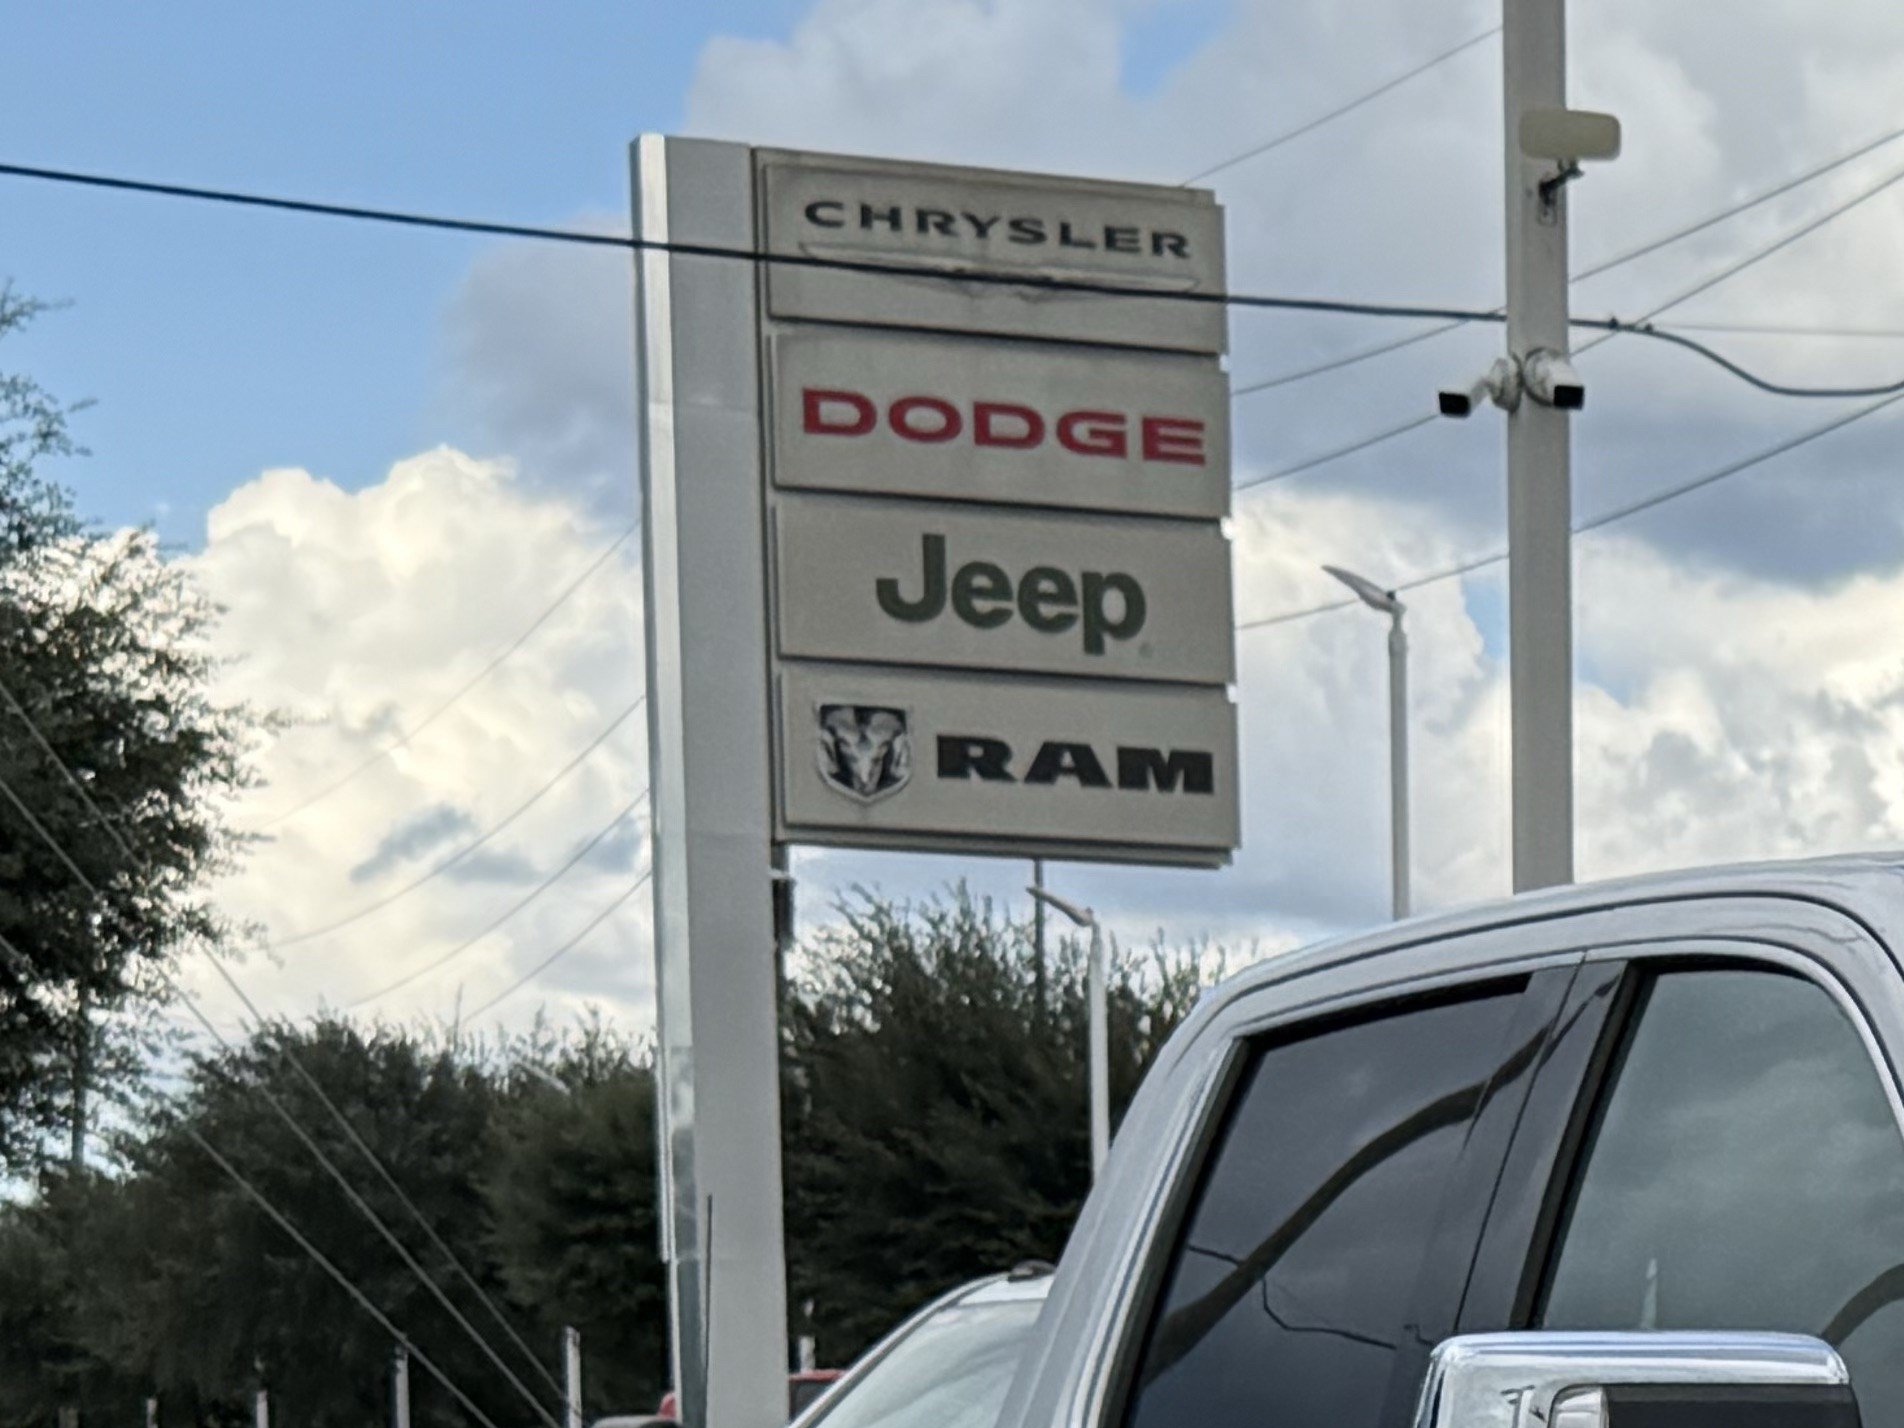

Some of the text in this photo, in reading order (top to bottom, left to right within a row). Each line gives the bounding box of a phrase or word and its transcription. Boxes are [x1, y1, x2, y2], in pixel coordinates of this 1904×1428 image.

[804, 201, 1191, 258] CHRYSLER
[802, 388, 1206, 464] DODGE
[876, 533, 1147, 655] Jeep
[937, 735, 1213, 795] RAM
